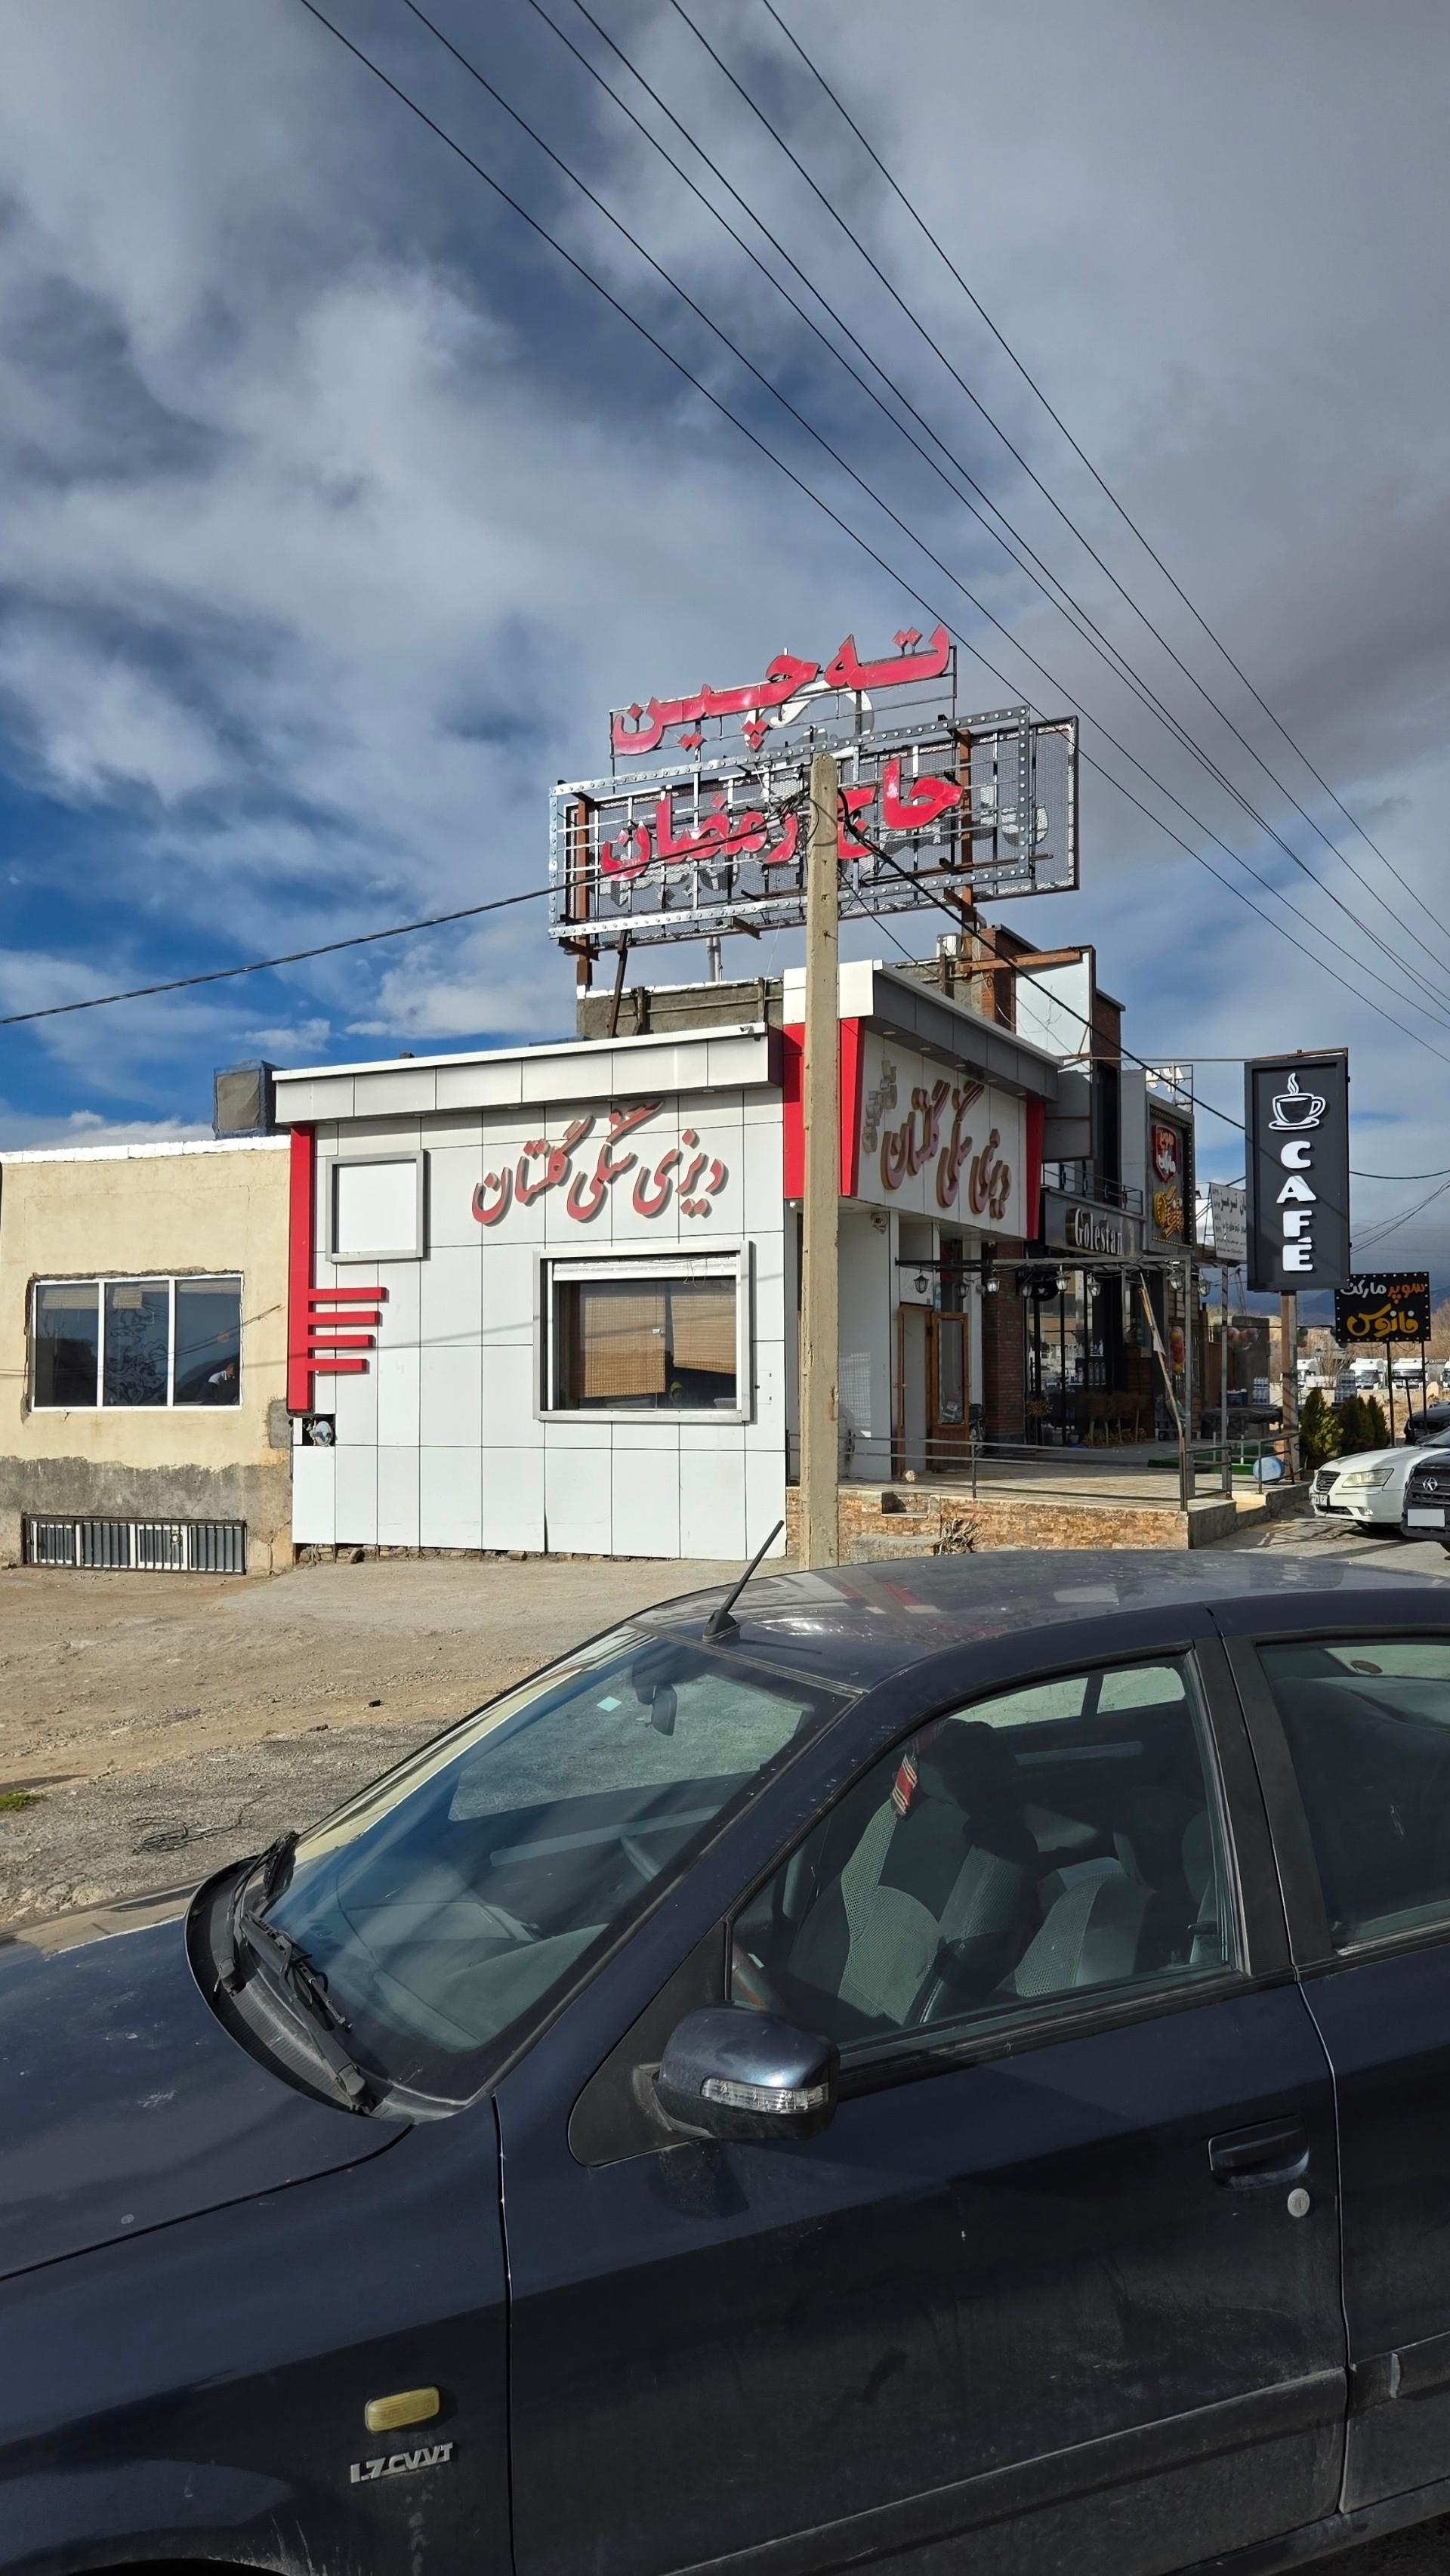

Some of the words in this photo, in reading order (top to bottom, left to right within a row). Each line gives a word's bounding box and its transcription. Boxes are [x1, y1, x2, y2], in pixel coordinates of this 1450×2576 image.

[601, 791, 798, 882] رمضان
[472, 1115, 594, 1225] گلستان
[567, 1101, 665, 1222] سنگی
[633, 1129, 727, 1218] دیزی
[881, 1080, 951, 1190] گلستان
[936, 1080, 985, 1208] سنگی
[969, 1129, 1012, 1219] دیزی
[1074, 1208, 1124, 1257] Golestan
[1340, 1279, 1387, 1299] مارکت
[1347, 1302, 1419, 1338] فانوس
[1387, 1283, 1426, 1305] سوپر
